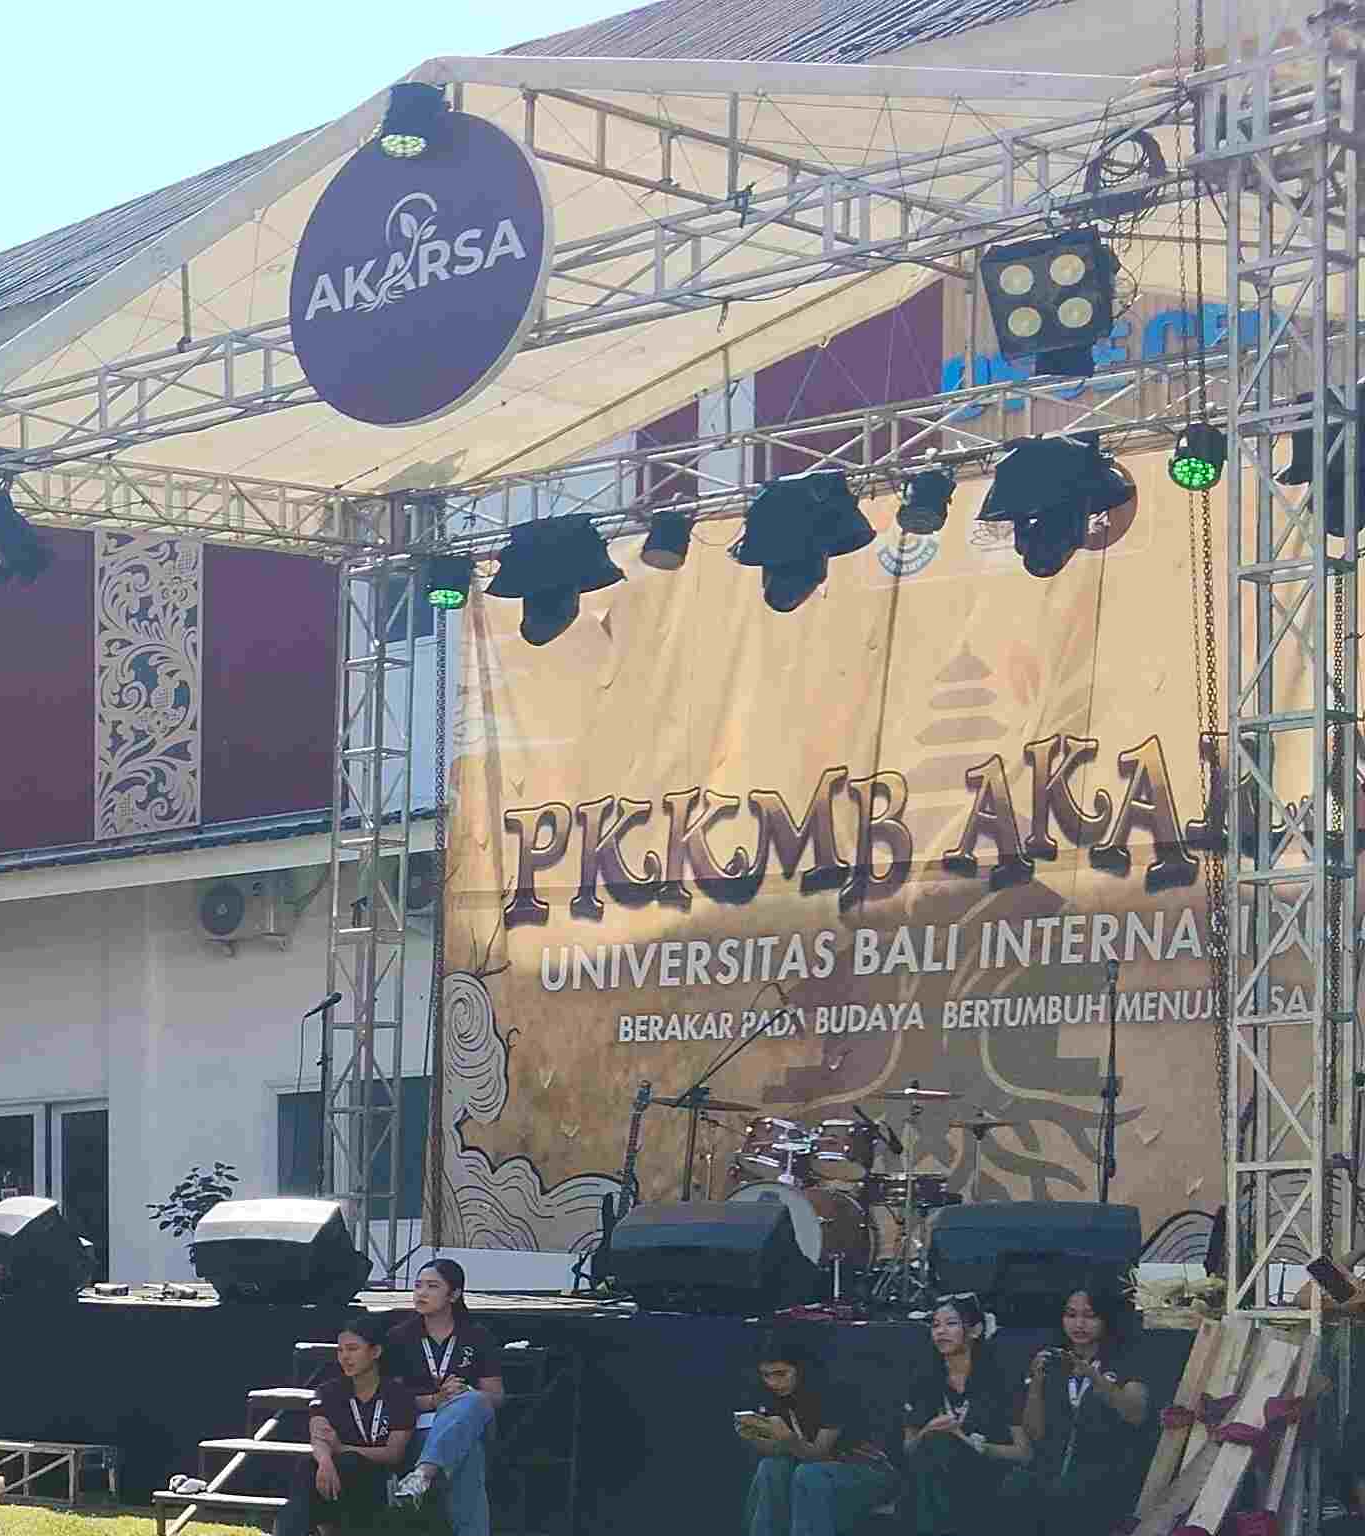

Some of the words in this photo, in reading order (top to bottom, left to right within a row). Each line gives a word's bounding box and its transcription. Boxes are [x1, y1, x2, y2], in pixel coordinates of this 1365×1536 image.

[304, 218, 527, 321] AKARSA
[502, 764, 913, 930] PKKMB
[540, 929, 837, 994] UNIVERSITAS
[853, 921, 959, 977] BALI
[618, 1012, 734, 1043] BERAKAR
[740, 1008, 806, 1039] PADA
[815, 1001, 925, 1034] BUDAYA
[942, 993, 1106, 1030] BERTUMBUH
